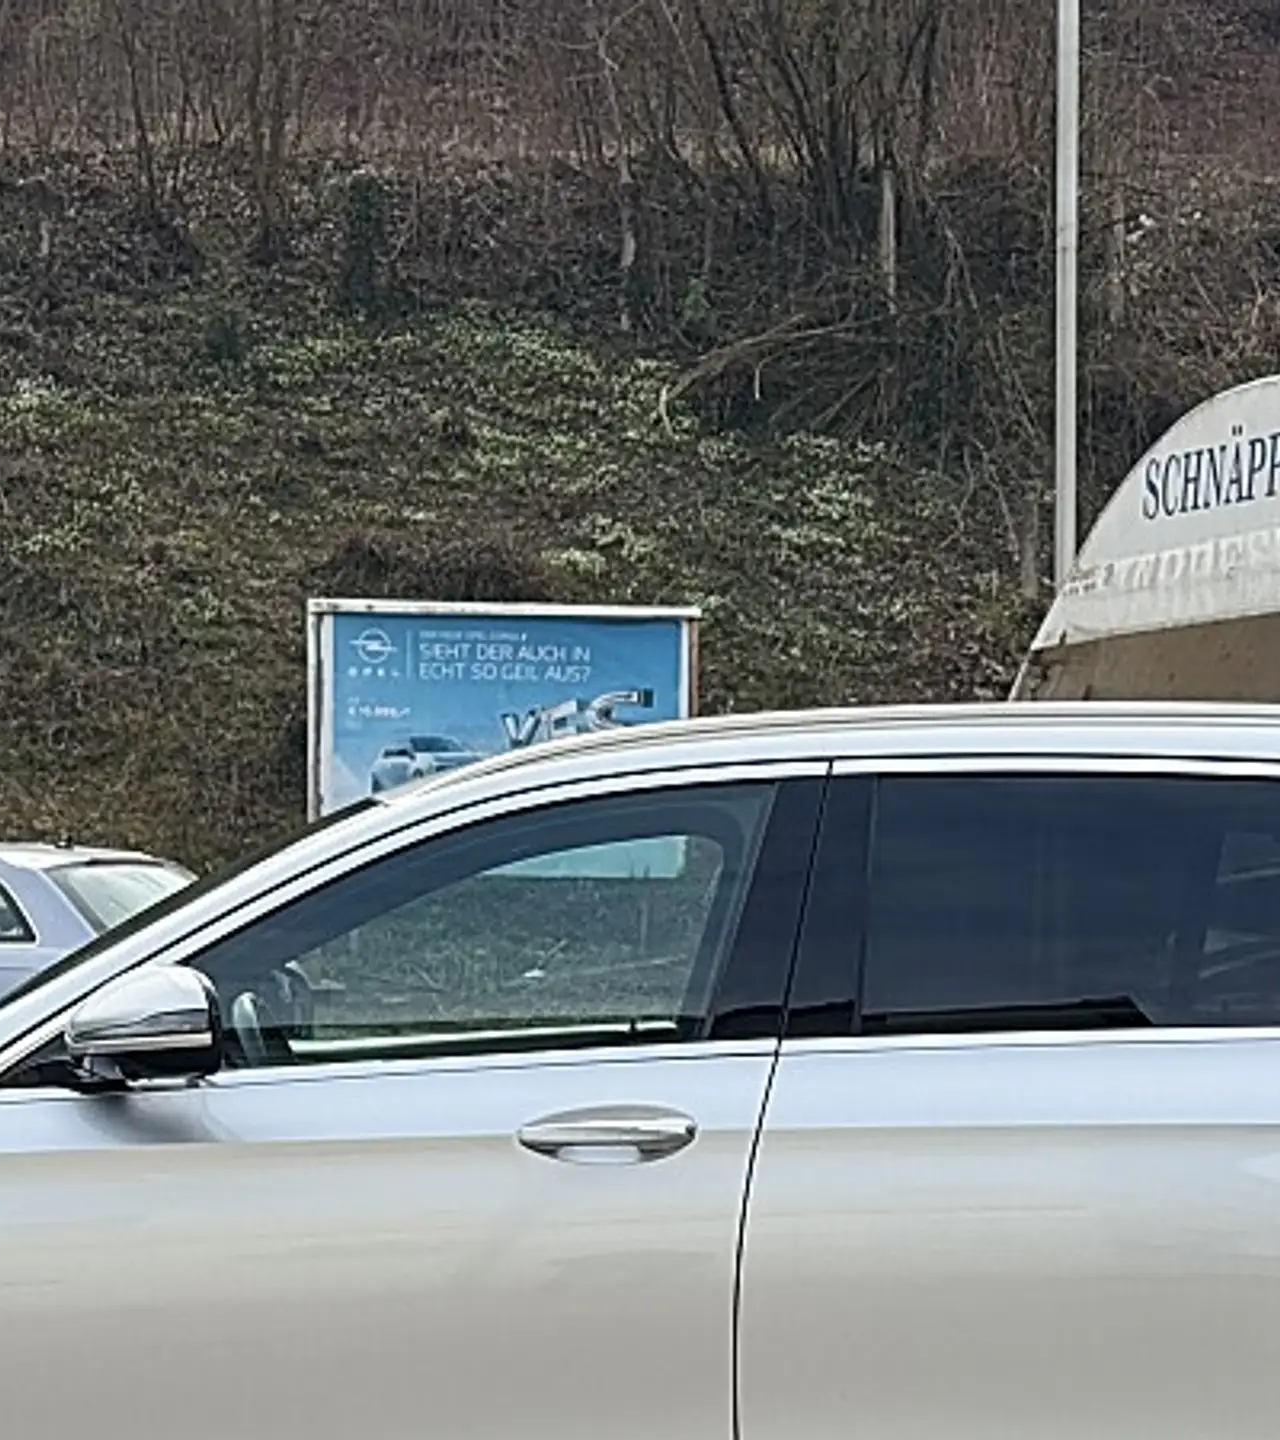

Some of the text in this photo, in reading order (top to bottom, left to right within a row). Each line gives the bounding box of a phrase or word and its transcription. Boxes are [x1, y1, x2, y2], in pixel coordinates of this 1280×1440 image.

[418, 642, 591, 663] SIEHT DER AUCH IN
[419, 662, 465, 680] ECHT
[470, 663, 496, 681] SO
[544, 664, 592, 683] AUS?
